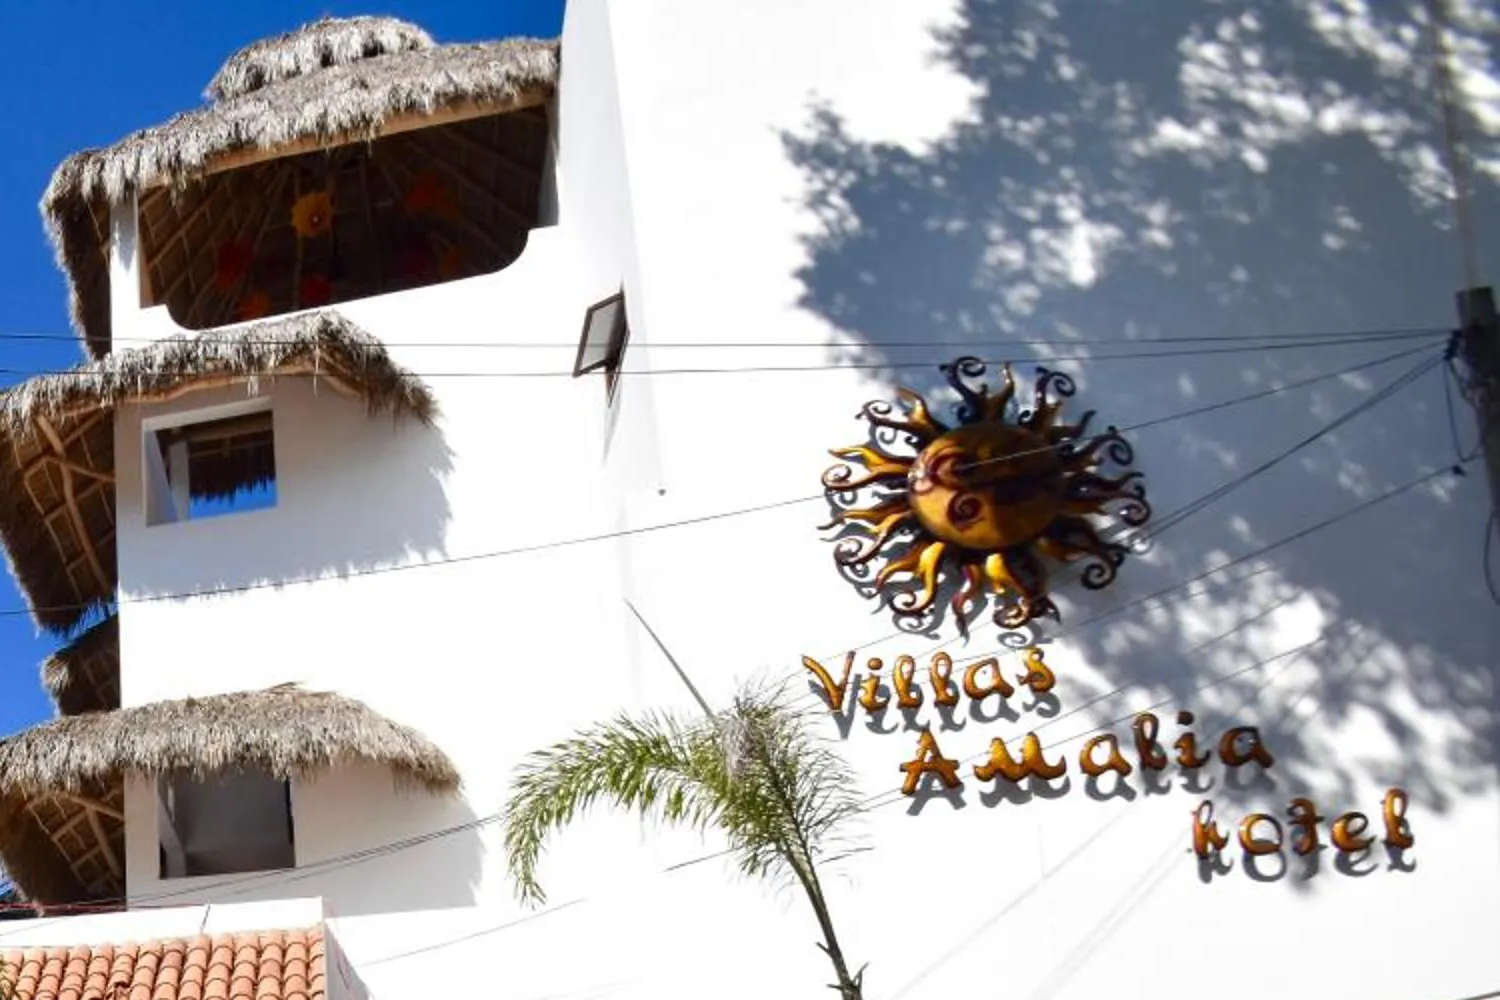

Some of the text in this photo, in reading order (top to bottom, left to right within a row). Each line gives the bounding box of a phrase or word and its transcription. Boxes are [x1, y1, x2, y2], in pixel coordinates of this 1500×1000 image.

[801, 646, 1056, 713] Villas
[899, 710, 1274, 796] Amalia
[1191, 787, 1415, 860] hotel
